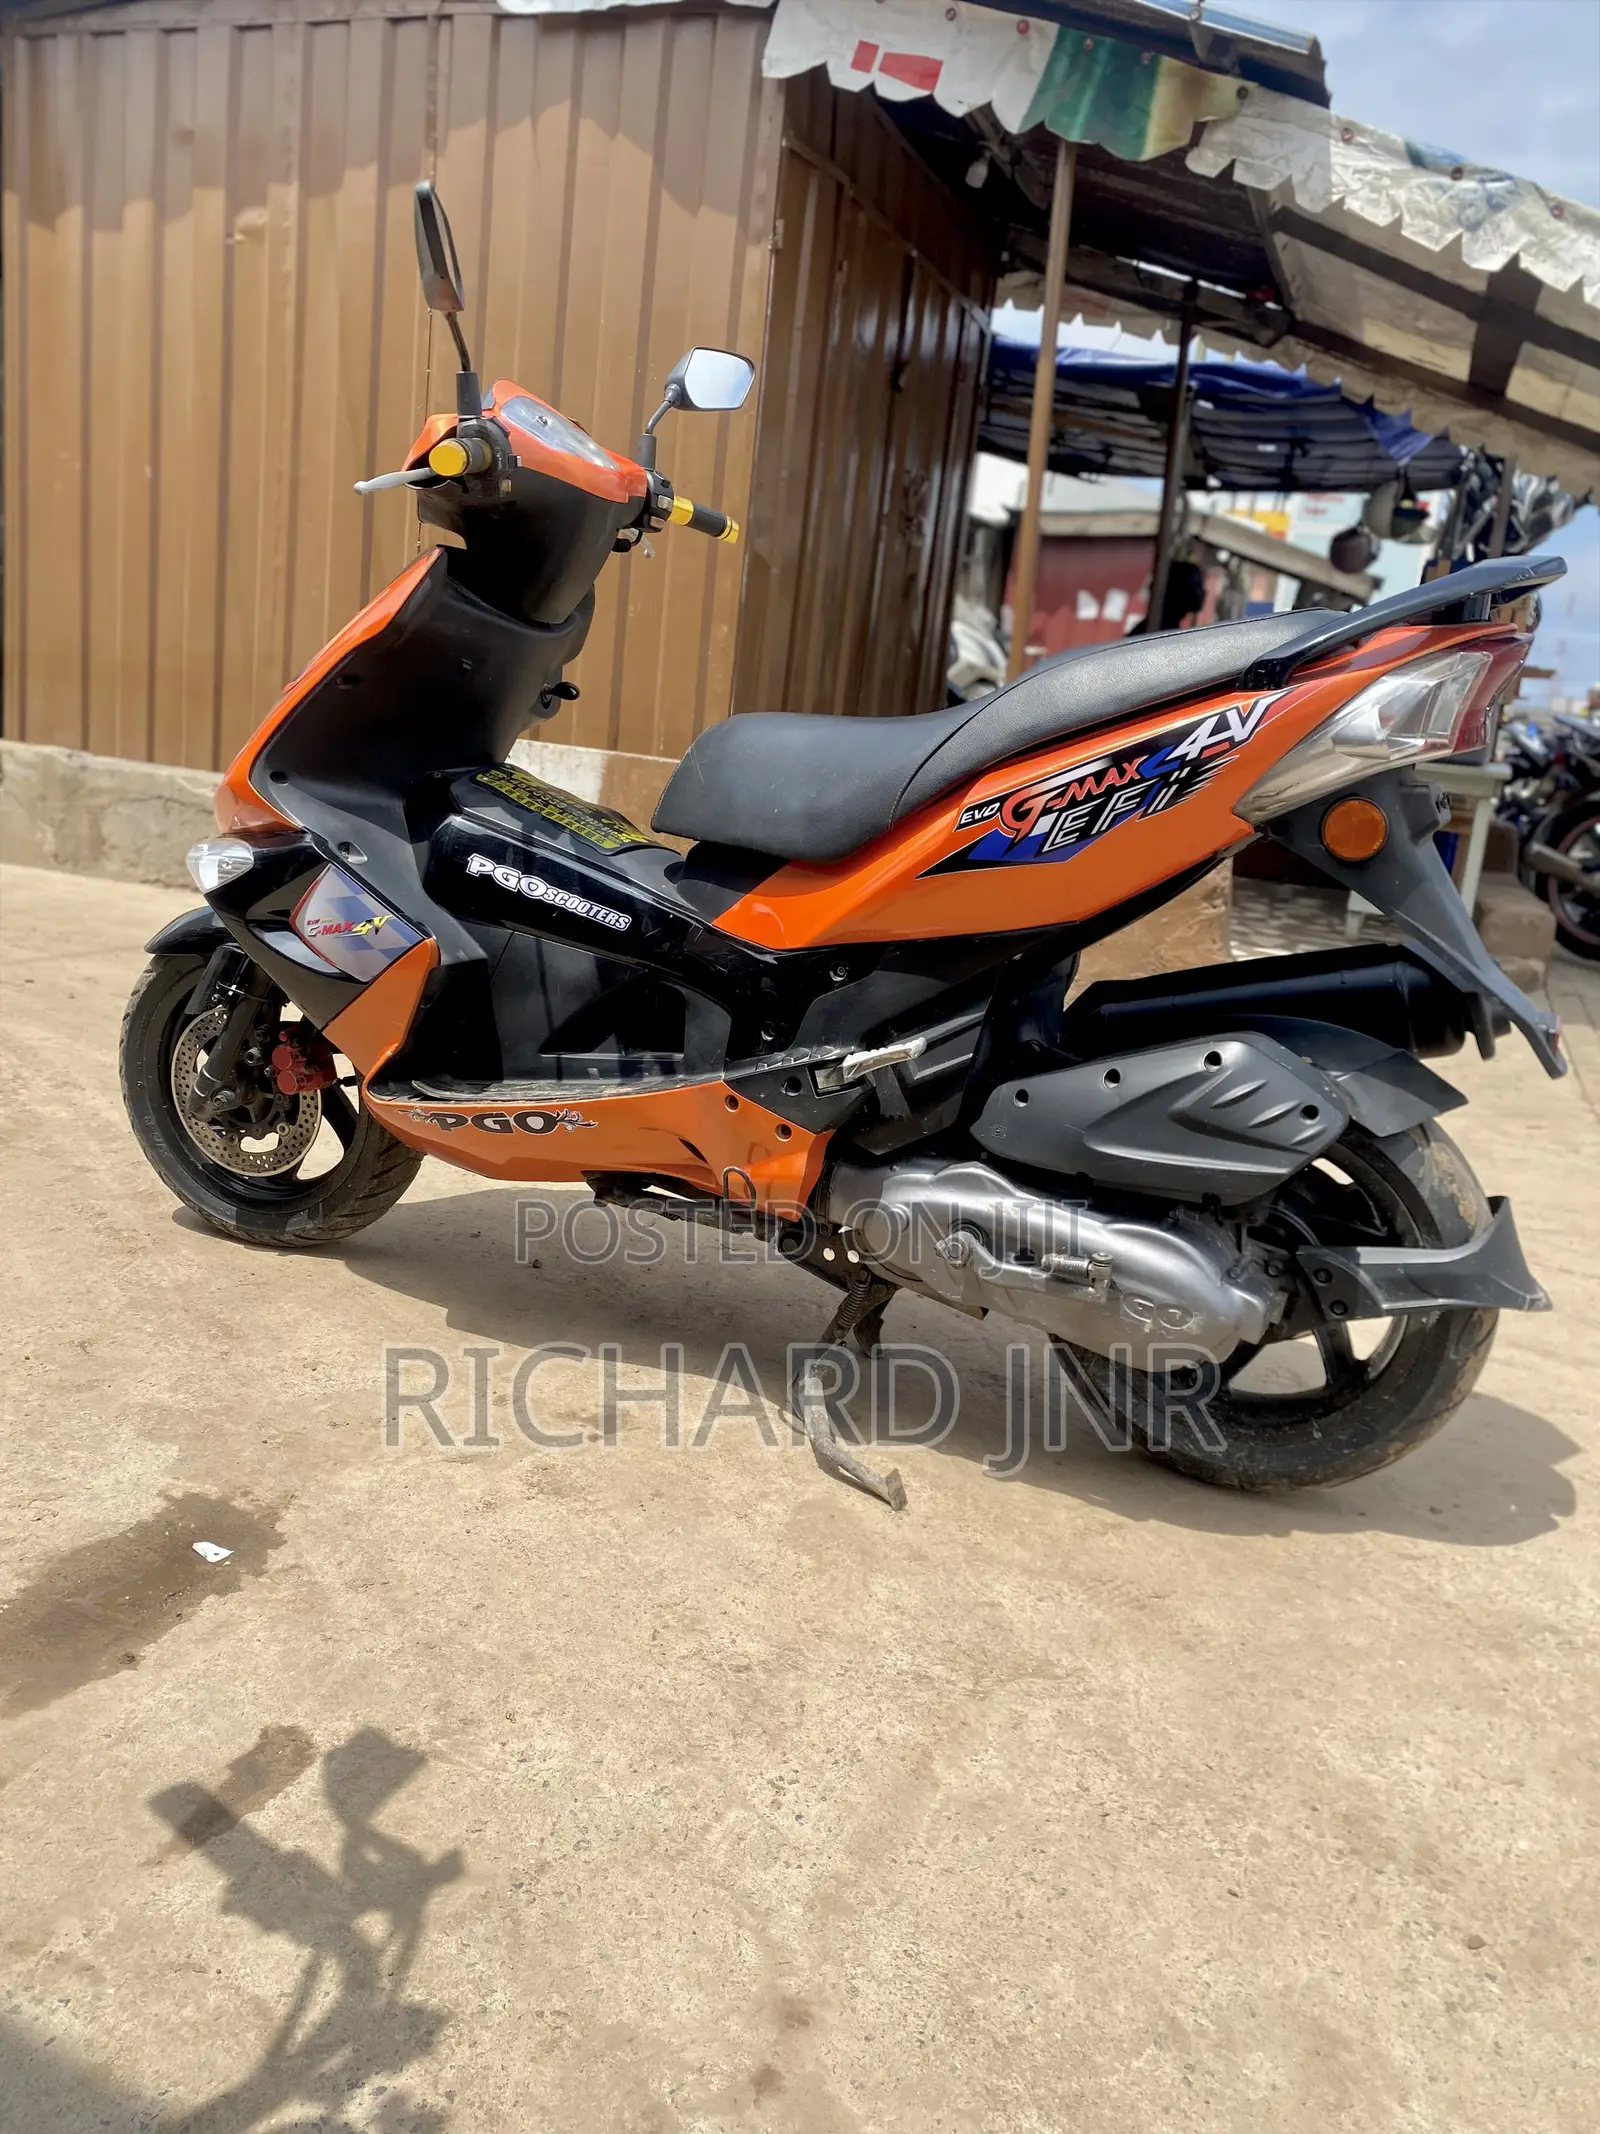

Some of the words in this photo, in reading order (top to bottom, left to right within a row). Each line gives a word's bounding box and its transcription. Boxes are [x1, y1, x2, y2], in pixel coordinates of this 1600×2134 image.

[961, 803, 1000, 826] EVO
[466, 853, 547, 898] PGO
[544, 883, 632, 931] SCOOTERS
[428, 1109, 557, 1135] PGO
